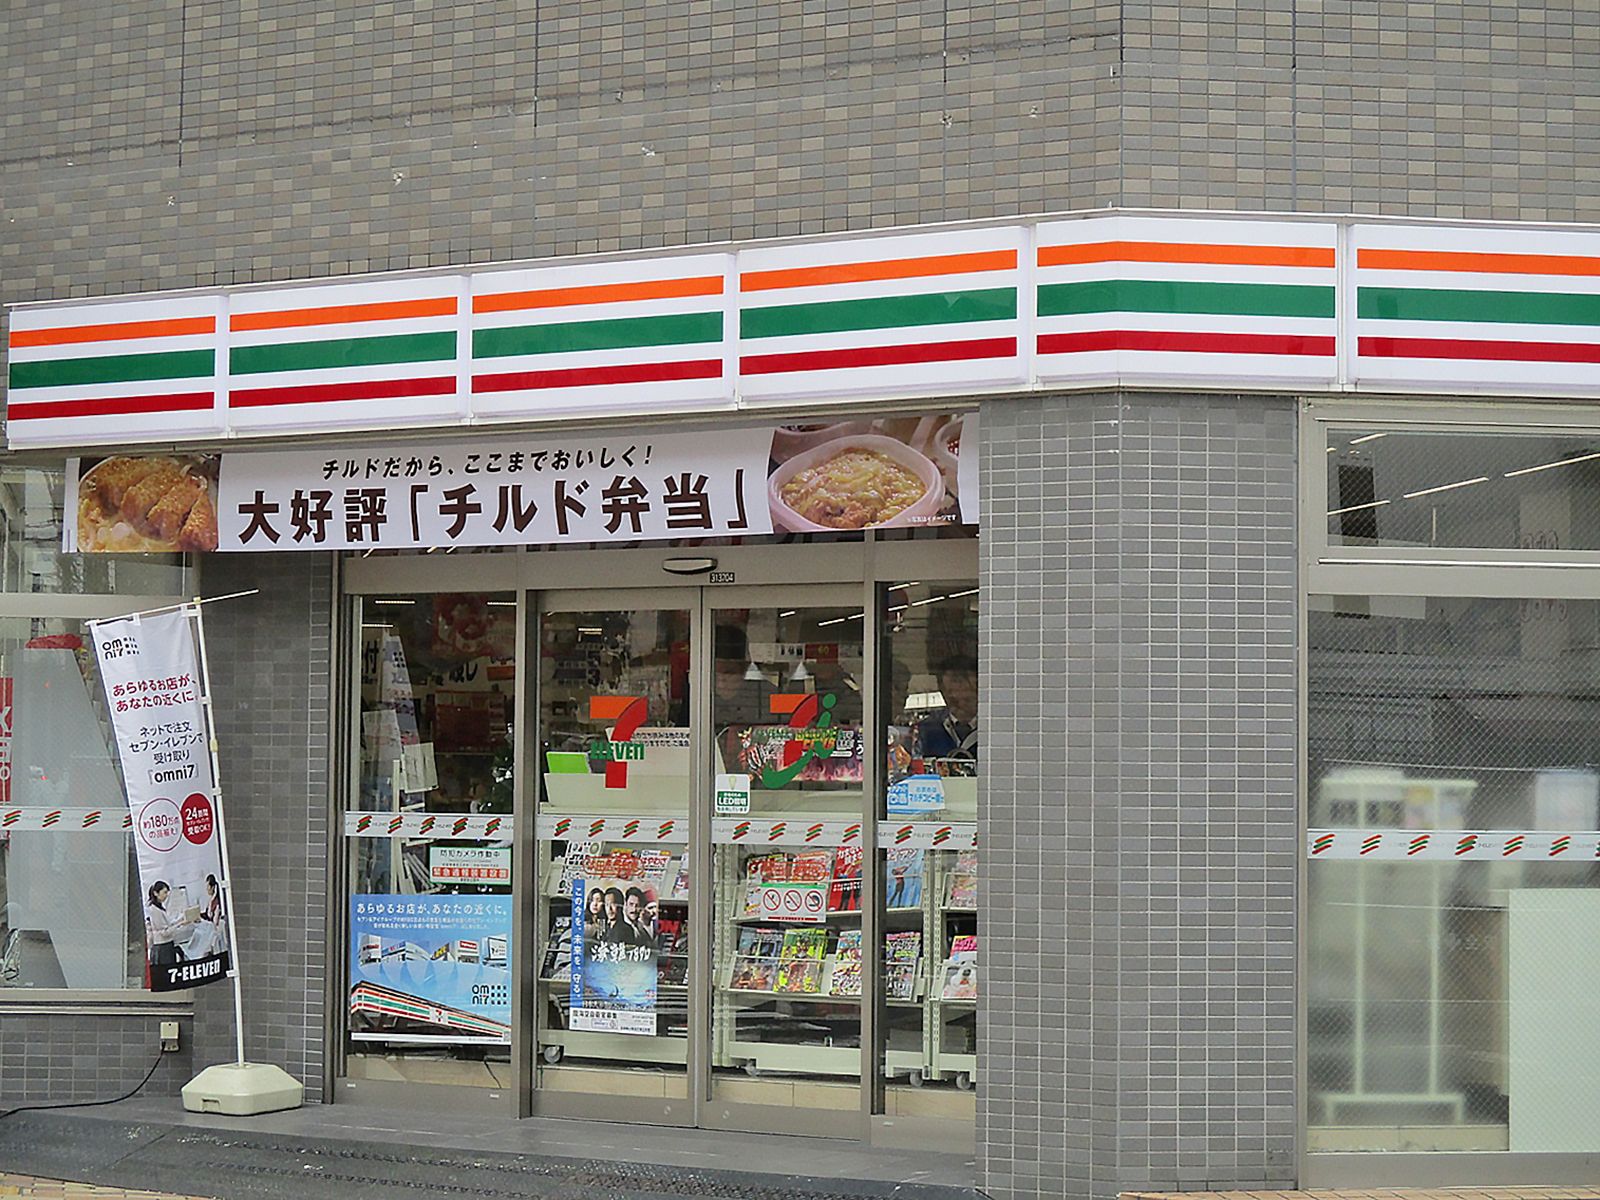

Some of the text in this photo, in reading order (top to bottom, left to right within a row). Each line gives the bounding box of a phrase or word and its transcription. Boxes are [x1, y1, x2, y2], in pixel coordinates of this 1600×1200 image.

[238, 468, 746, 545] 大好評「チルド弁当」
[113, 673, 196, 697] あらゆるお店が、
[140, 721, 192, 738] ネットで注文
[153, 750, 189, 765] 受け取り
[357, 903, 507, 916] あらゆるお店が、あなたの近くに。
